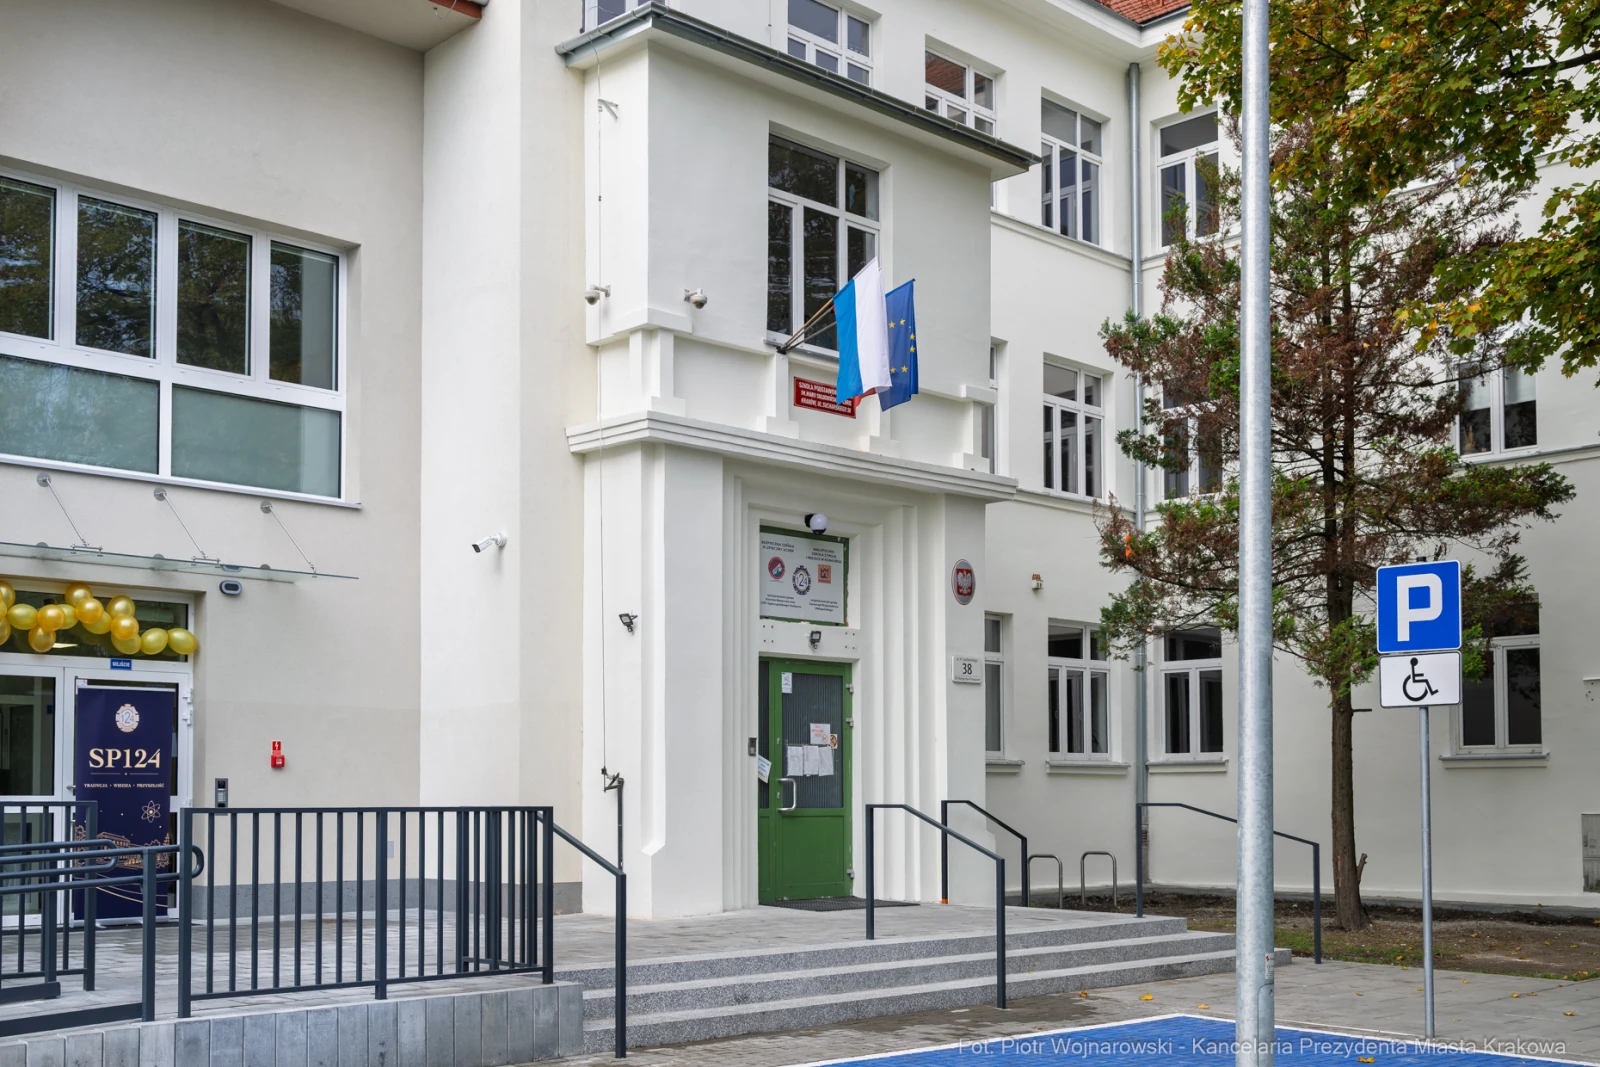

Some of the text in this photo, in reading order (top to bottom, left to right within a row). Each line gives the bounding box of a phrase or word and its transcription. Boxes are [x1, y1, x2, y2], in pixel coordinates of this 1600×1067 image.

[796, 573, 808, 586] 124
[1397, 573, 1443, 642] P
[962, 663, 972, 675] 38
[121, 711, 134, 724] 124
[88, 748, 160, 768] SP124
